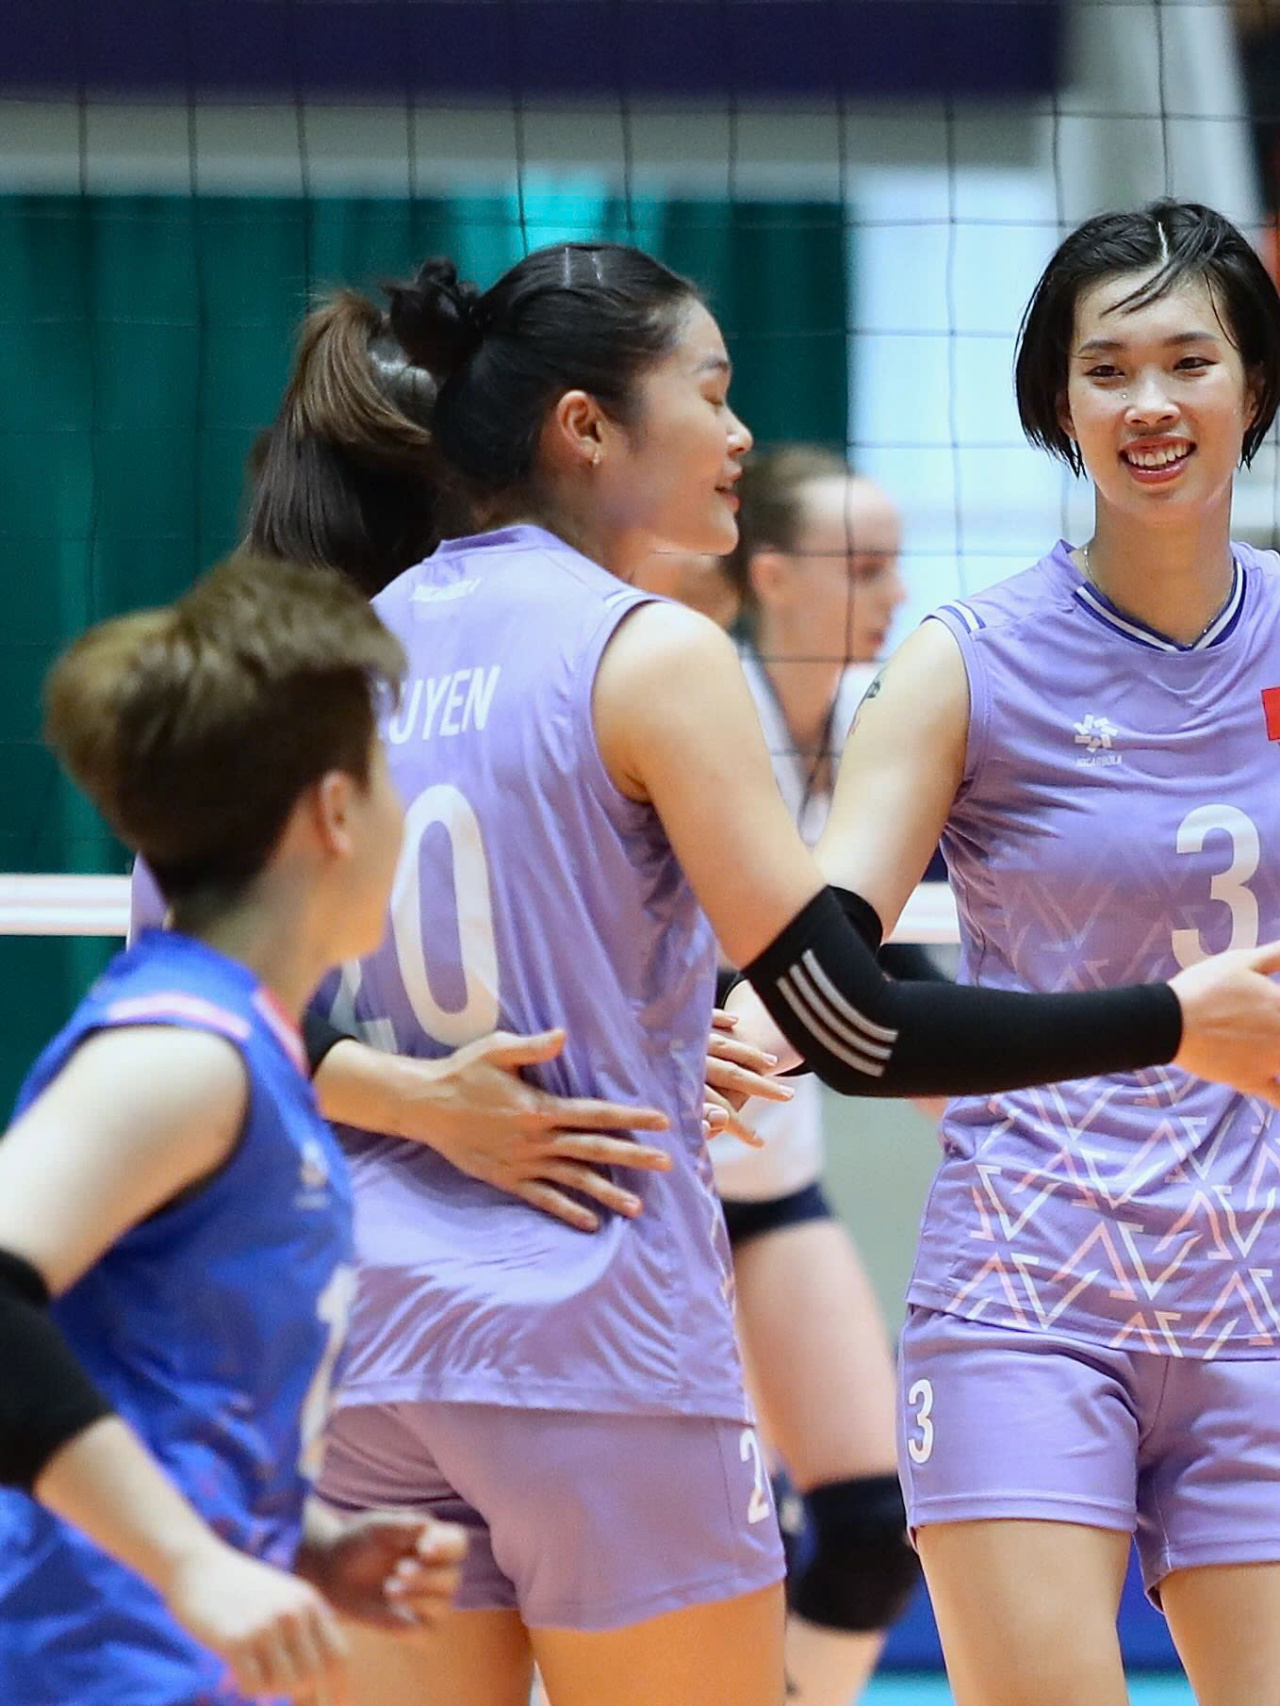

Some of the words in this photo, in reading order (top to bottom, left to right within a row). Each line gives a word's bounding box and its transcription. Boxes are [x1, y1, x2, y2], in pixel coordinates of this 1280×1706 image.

[377, 664, 501, 745] UYEN
[1171, 803, 1260, 972] 3
[907, 1378, 935, 1464] 3
[739, 1427, 772, 1524] 2
